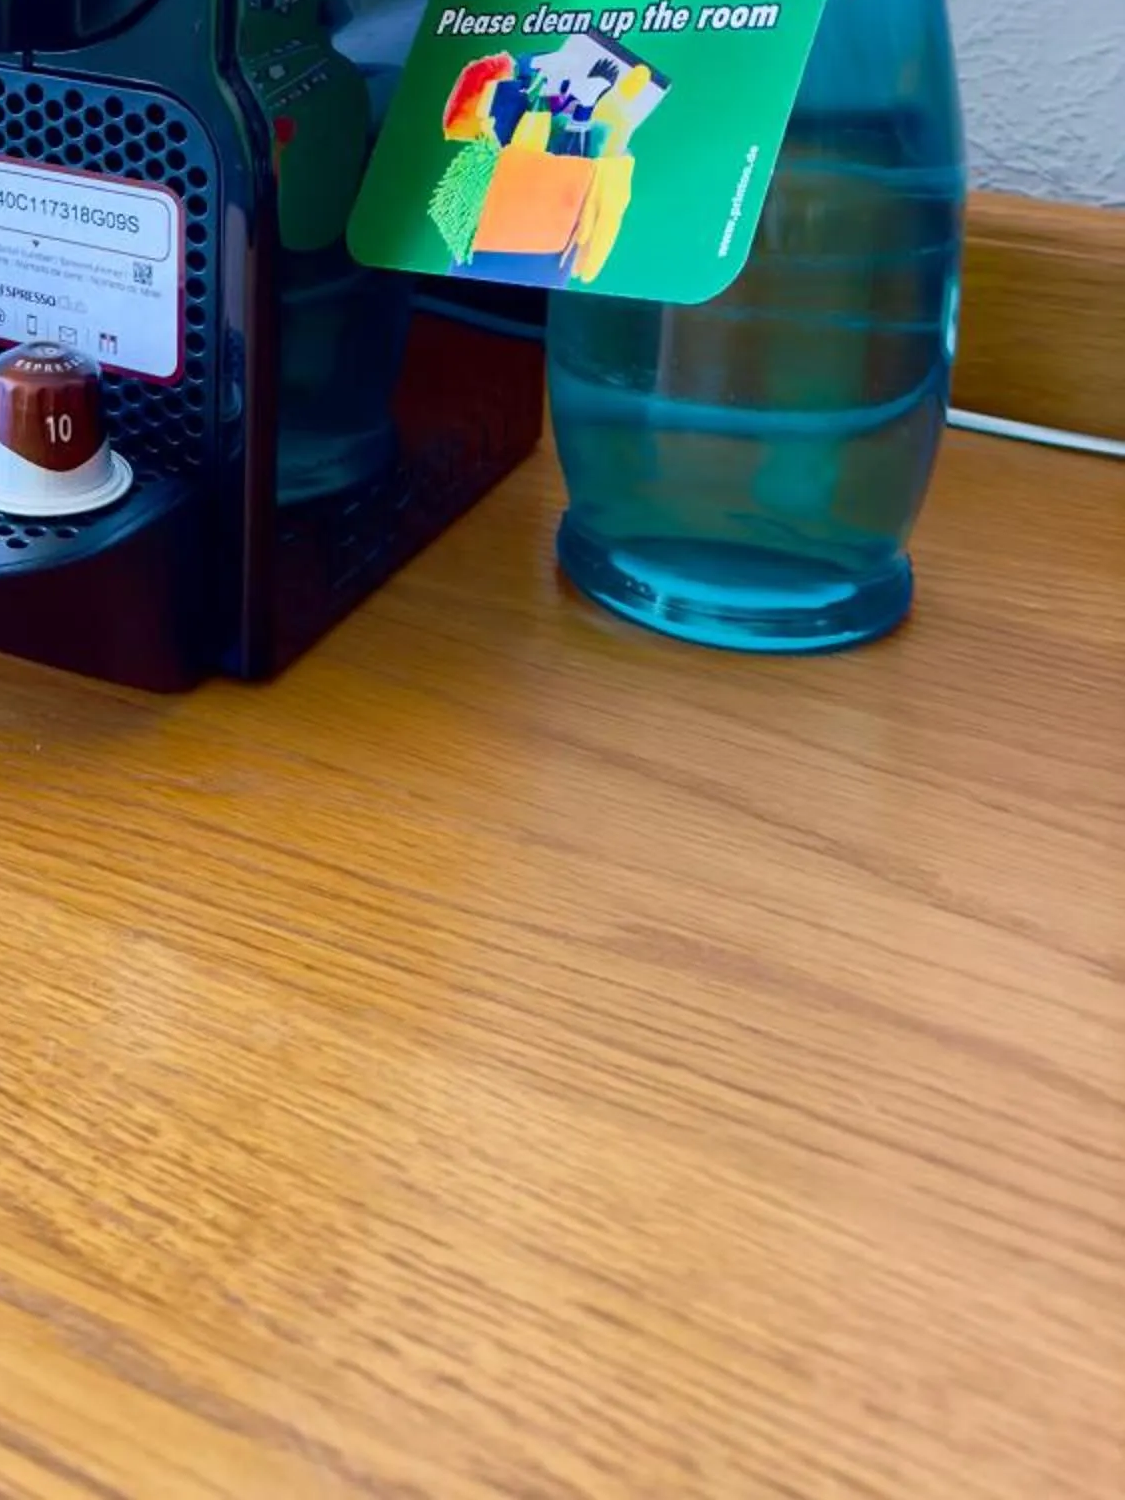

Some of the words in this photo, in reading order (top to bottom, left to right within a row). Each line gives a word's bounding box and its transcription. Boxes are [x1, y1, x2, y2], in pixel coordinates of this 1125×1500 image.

[436, 4, 515, 36] Please
[521, 2, 591, 34] clean
[599, 7, 633, 39] up
[697, 2, 780, 31] room
[45, 413, 73, 443] 10
